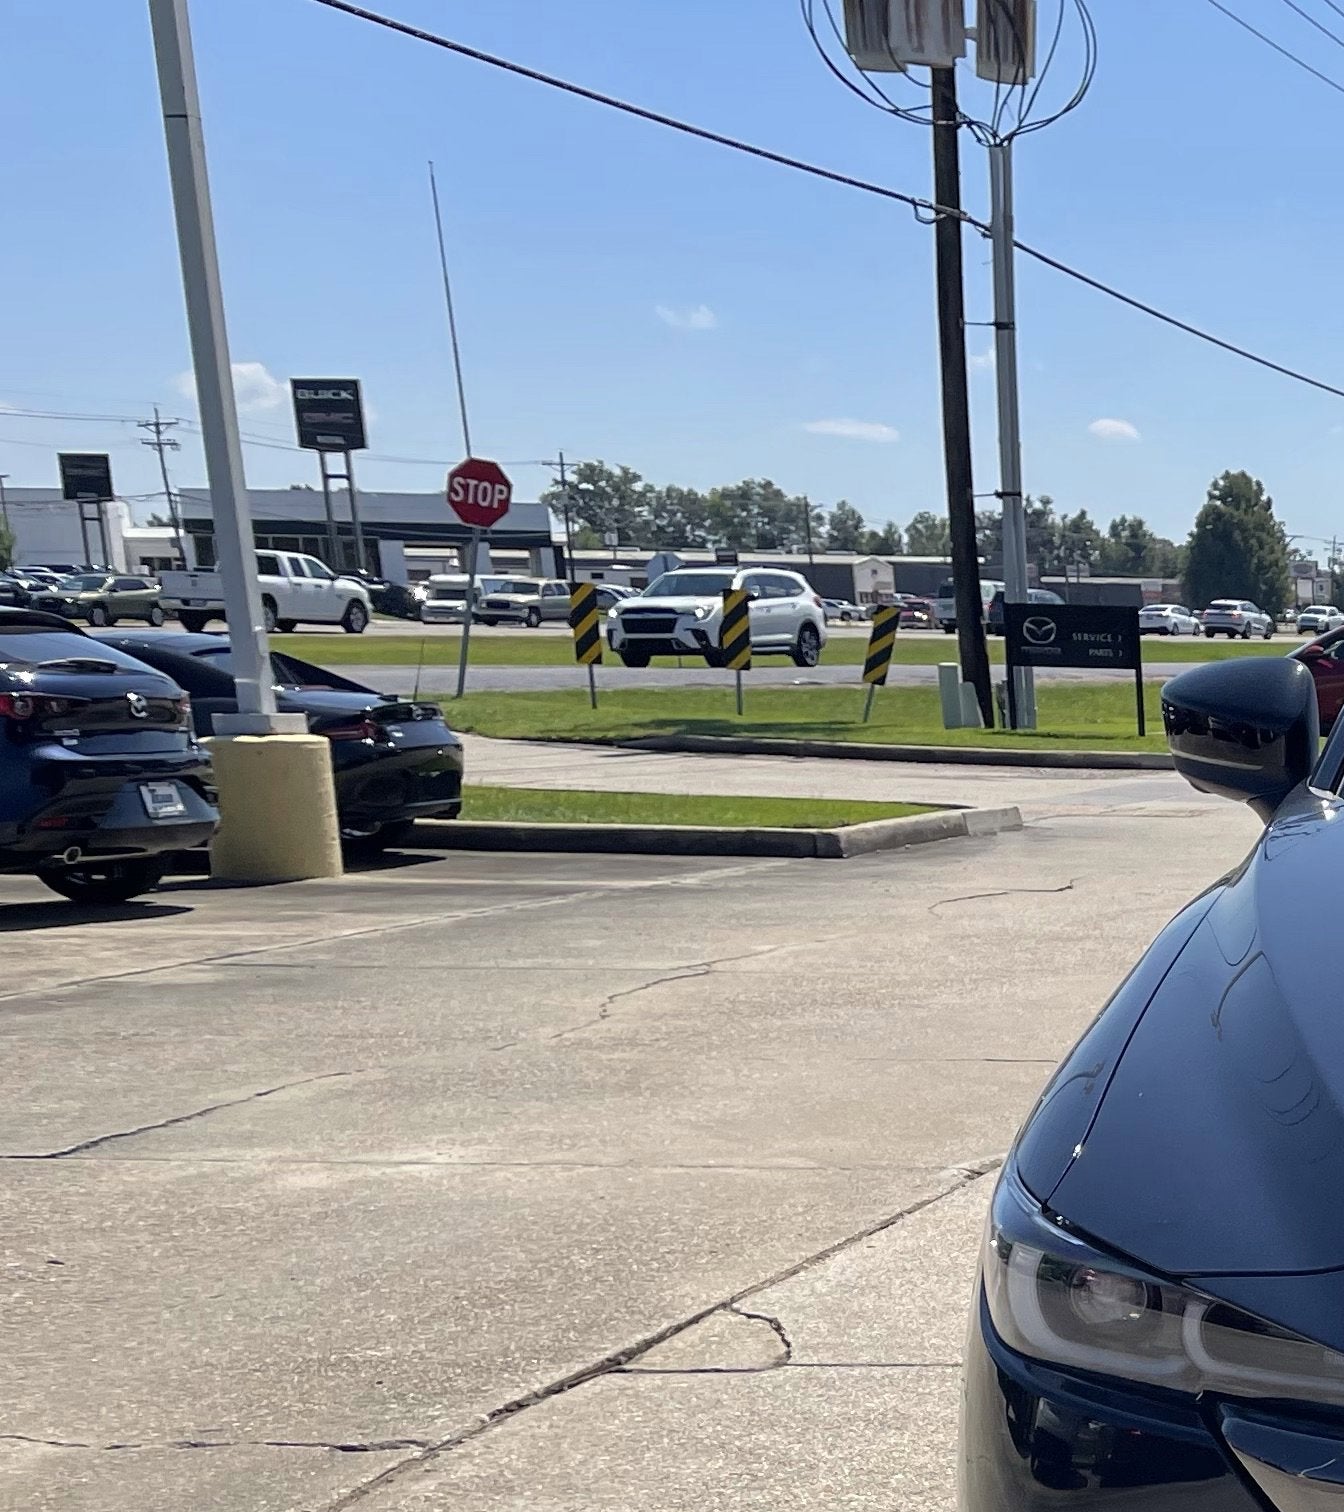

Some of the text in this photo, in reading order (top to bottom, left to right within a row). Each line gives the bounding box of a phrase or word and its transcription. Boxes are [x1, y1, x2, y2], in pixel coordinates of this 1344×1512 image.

[296, 389, 354, 400] BUICK
[450, 476, 508, 509] STOP
[1072, 632, 1113, 642] SERVICE
[1088, 648, 1114, 657] PARTS
